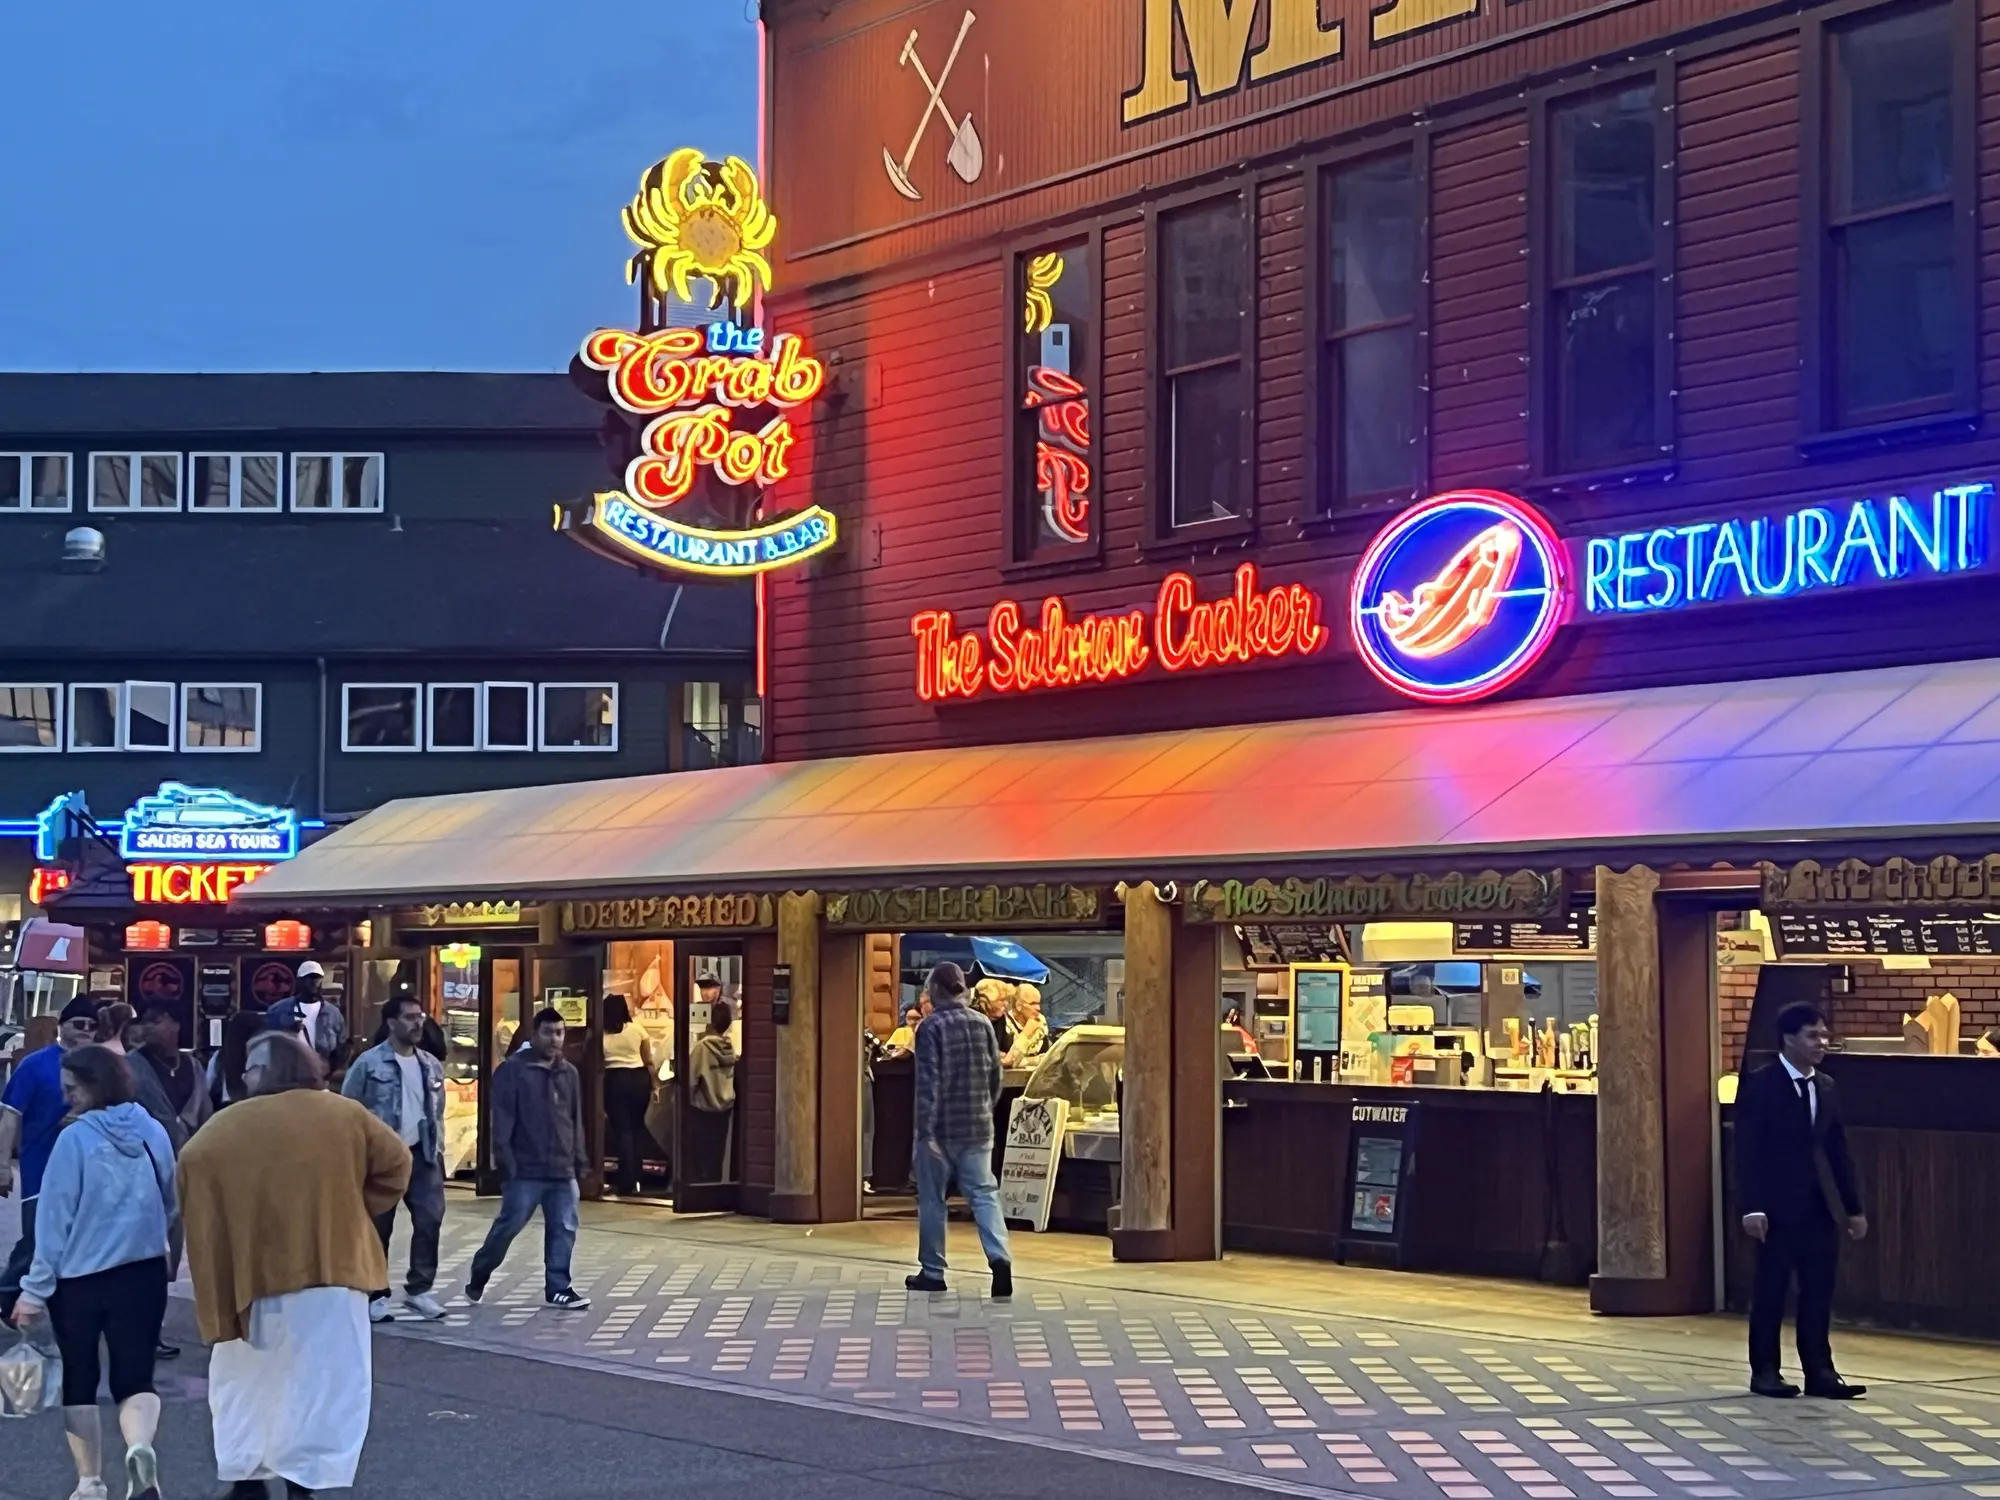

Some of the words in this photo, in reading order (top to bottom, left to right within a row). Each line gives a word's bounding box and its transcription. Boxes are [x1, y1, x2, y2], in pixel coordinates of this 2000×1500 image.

[708, 322, 764, 352] the
[580, 328, 826, 412] Crab
[626, 406, 796, 507] Pot
[606, 500, 757, 566] RESTAURANT
[763, 536, 782, 559] &
[783, 517, 829, 553] BAR
[1585, 484, 1992, 614] RESTAURANT
[911, 610, 984, 701] The
[987, 596, 1150, 693] Salmon
[1155, 562, 1325, 672] Cooker
[137, 833, 193, 848] SALISH
[196, 833, 226, 848] SEA
[229, 833, 280, 848] TOURS
[126, 863, 274, 903] TICKET
[1222, 880, 1269, 916] The
[1273, 876, 1390, 916] Salmon
[1399, 873, 1515, 912] Cooker
[576, 896, 658, 929] DEEP
[662, 893, 757, 929] FRIED
[853, 886, 983, 924] OYSTER
[986, 884, 1074, 921] BAR
[1352, 1105, 1409, 1122] CUTWATER
